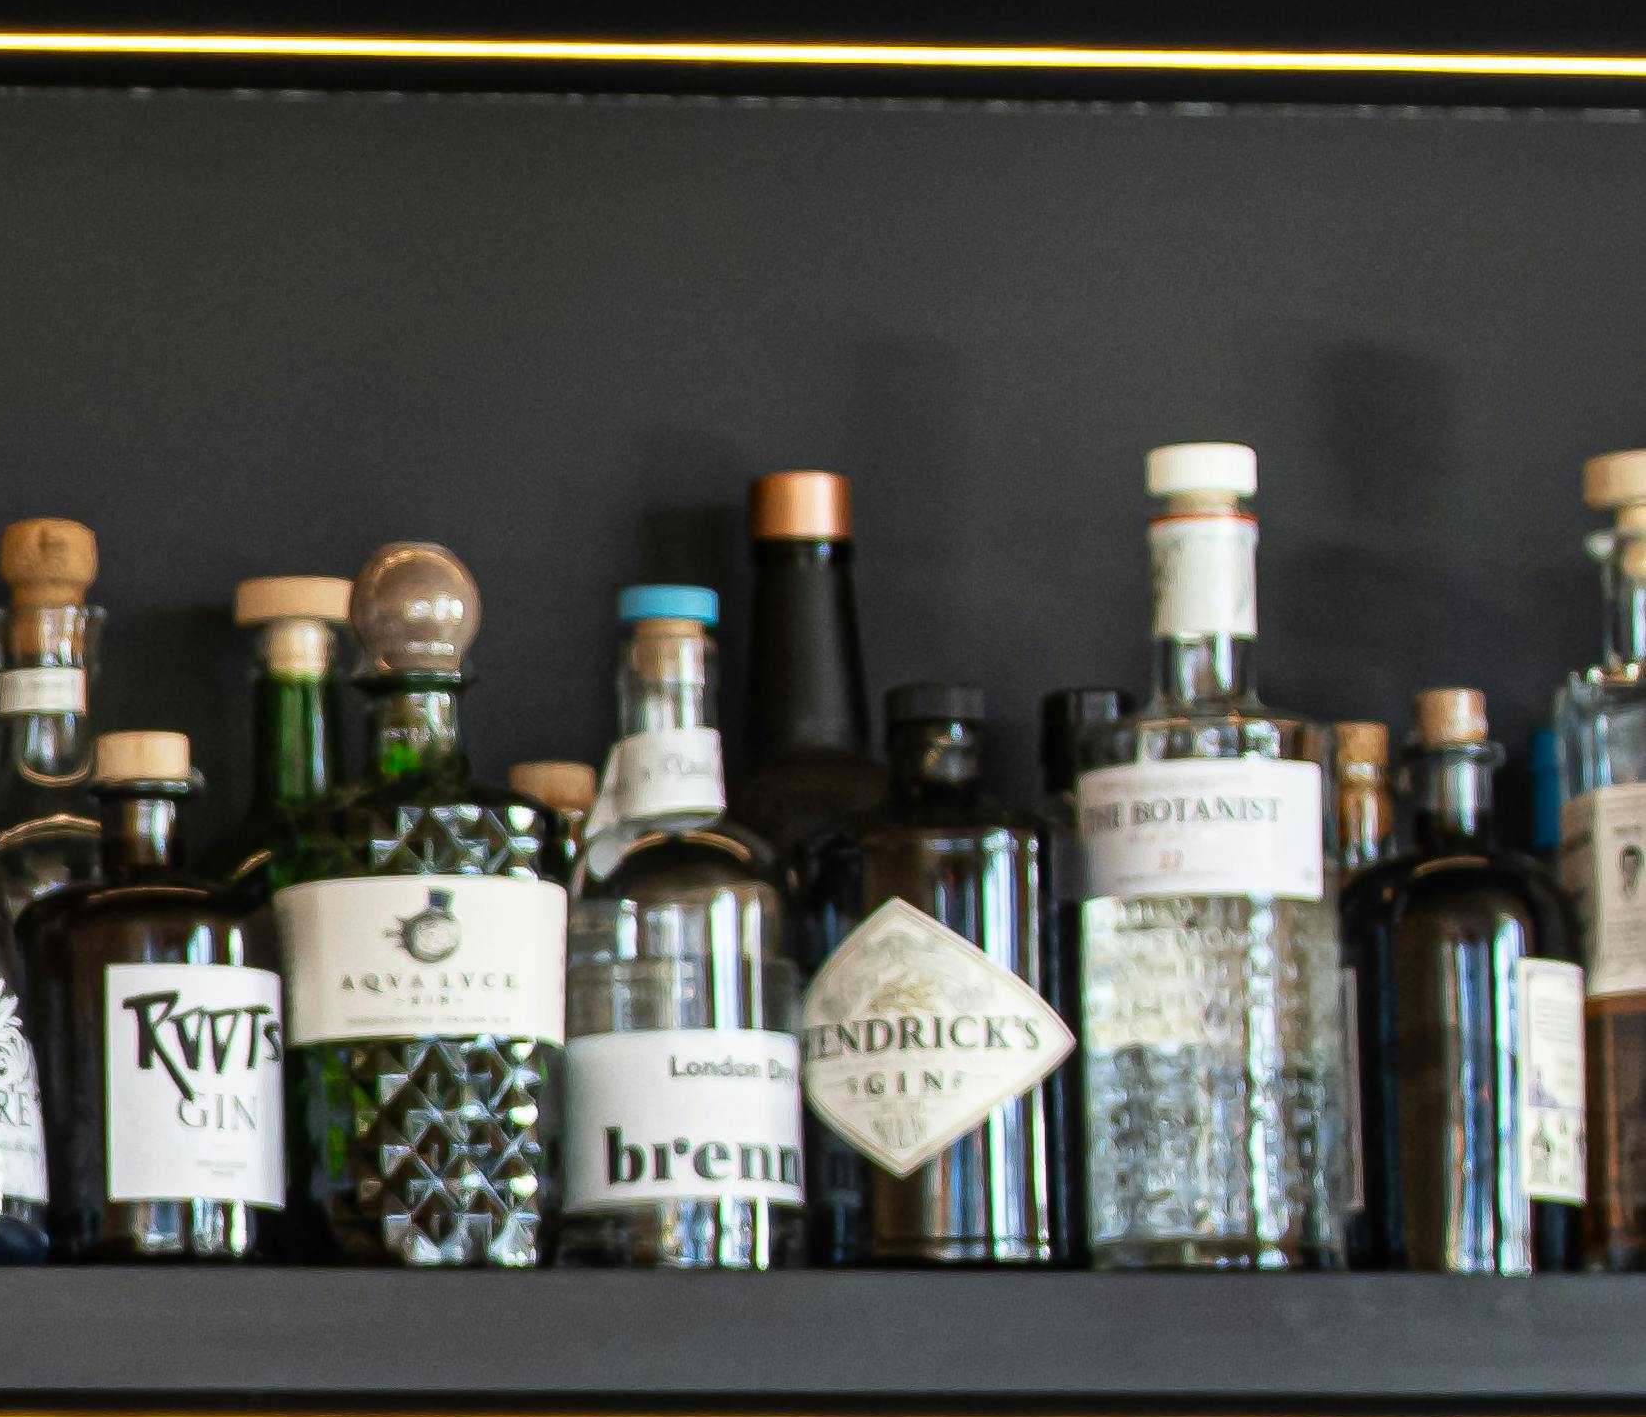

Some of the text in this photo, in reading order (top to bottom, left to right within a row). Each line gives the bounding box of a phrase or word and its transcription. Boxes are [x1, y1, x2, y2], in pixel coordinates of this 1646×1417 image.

[1131, 796, 1283, 825] BOTANIST
[669, 1054, 762, 1078] London
[177, 1093, 258, 1131] GIN
